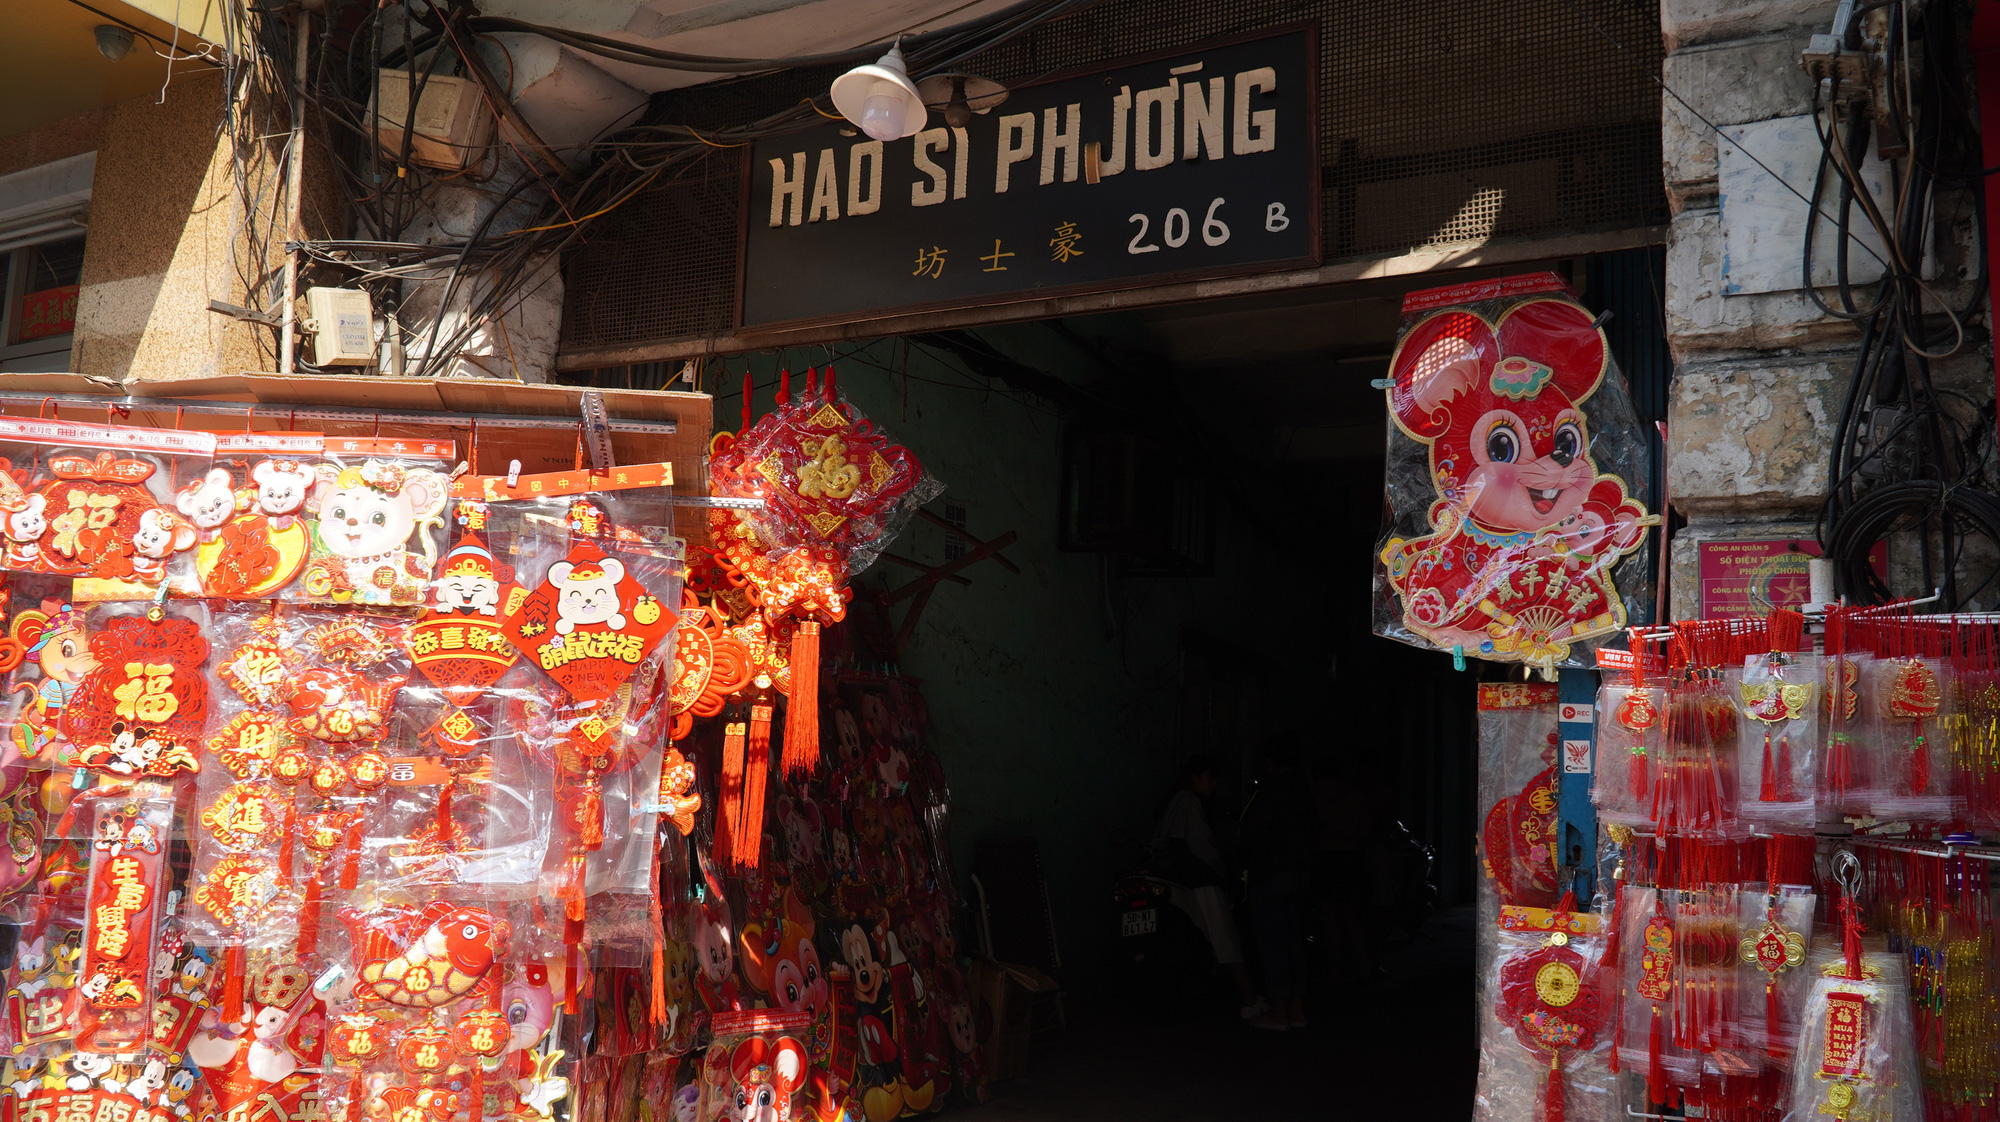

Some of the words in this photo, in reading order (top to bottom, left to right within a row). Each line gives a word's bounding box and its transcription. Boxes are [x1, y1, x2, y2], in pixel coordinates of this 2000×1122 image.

[1127, 197, 1231, 255] 206
[1265, 201, 1291, 233] B
[1719, 554, 1733, 565] SỐ
[1734, 556, 1758, 565] ĐIỆN
[1730, 544, 1741, 552] AN
[1773, 564, 1807, 575] CHỐNG
[569, 659, 616, 672] HAPPY
[577, 672, 606, 682] NEW
[112, 661, 180, 724] 福
[327, 709, 353, 735] 福
[230, 797, 269, 834] 進
[95, 857, 146, 958] 生意興隆
[405, 967, 430, 992] 福
[470, 1026, 494, 1051] 福
[1833, 1024, 1853, 1033] MUA
[1833, 1033, 1853, 1042] MAY
[347, 1030, 372, 1055] 福
[415, 1044, 440, 1069] 福
